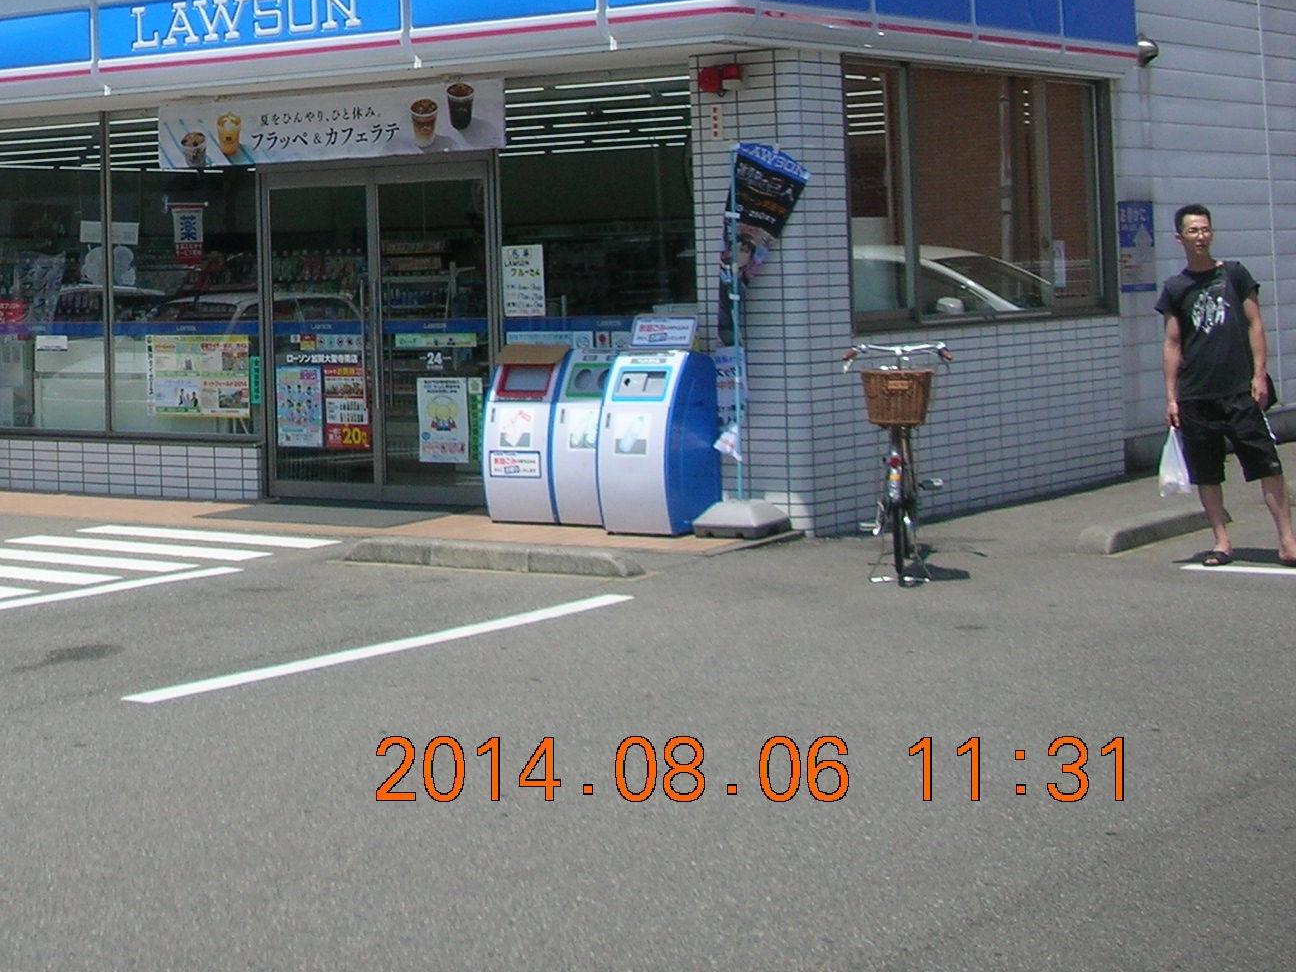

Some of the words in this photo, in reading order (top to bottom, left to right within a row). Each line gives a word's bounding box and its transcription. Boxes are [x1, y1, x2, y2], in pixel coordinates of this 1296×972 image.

[260, 106, 382, 127] 夏をひんやり、ひと休み。
[426, 352, 443, 365] 24
